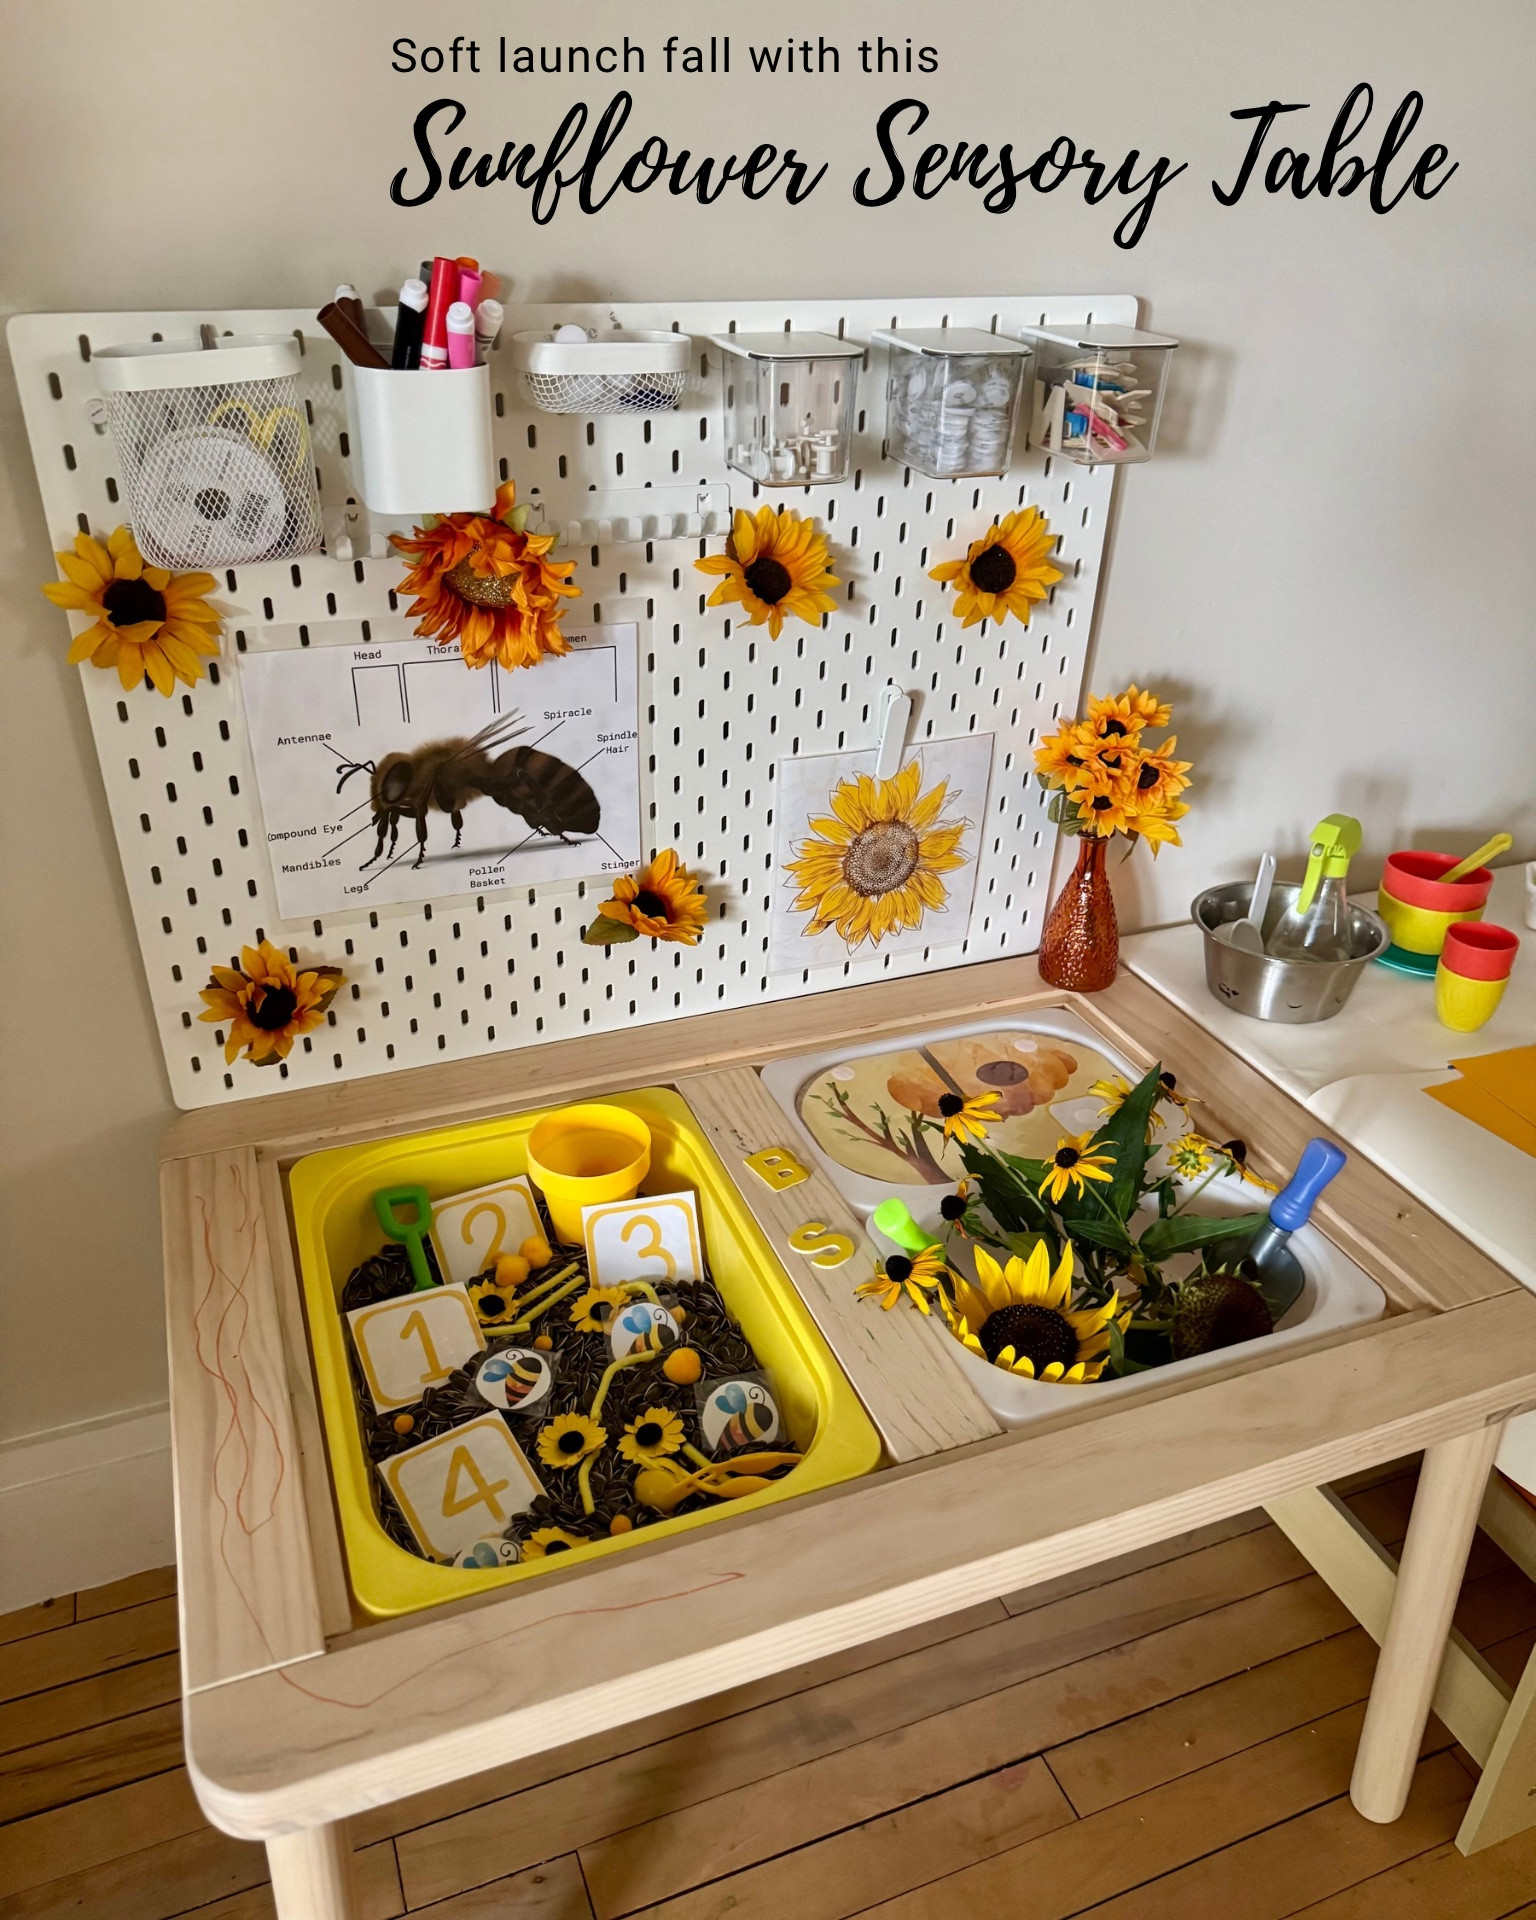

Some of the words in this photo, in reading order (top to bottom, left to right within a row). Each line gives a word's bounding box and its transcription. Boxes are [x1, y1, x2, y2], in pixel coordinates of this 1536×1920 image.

[353, 649, 382, 661] Head
[426, 644, 462, 655] Thora
[543, 707, 593, 721] Spiracle
[277, 733, 332, 746] Antennae
[596, 730, 638, 743] Spindle
[605, 744, 630, 755] Hair
[323, 824, 343, 835] Eye
[281, 858, 342, 874] Mandibles
[468, 864, 506, 877] Pollen
[600, 859, 641, 871] Stinger
[343, 884, 370, 894] Legs
[469, 877, 507, 889] Basket
[742, 1146, 813, 1193] B
[461, 1202, 507, 1277] 2
[787, 1221, 856, 1270] S
[620, 1214, 678, 1283] 3
[399, 1309, 456, 1383] 1
[441, 1444, 510, 1524] 4
